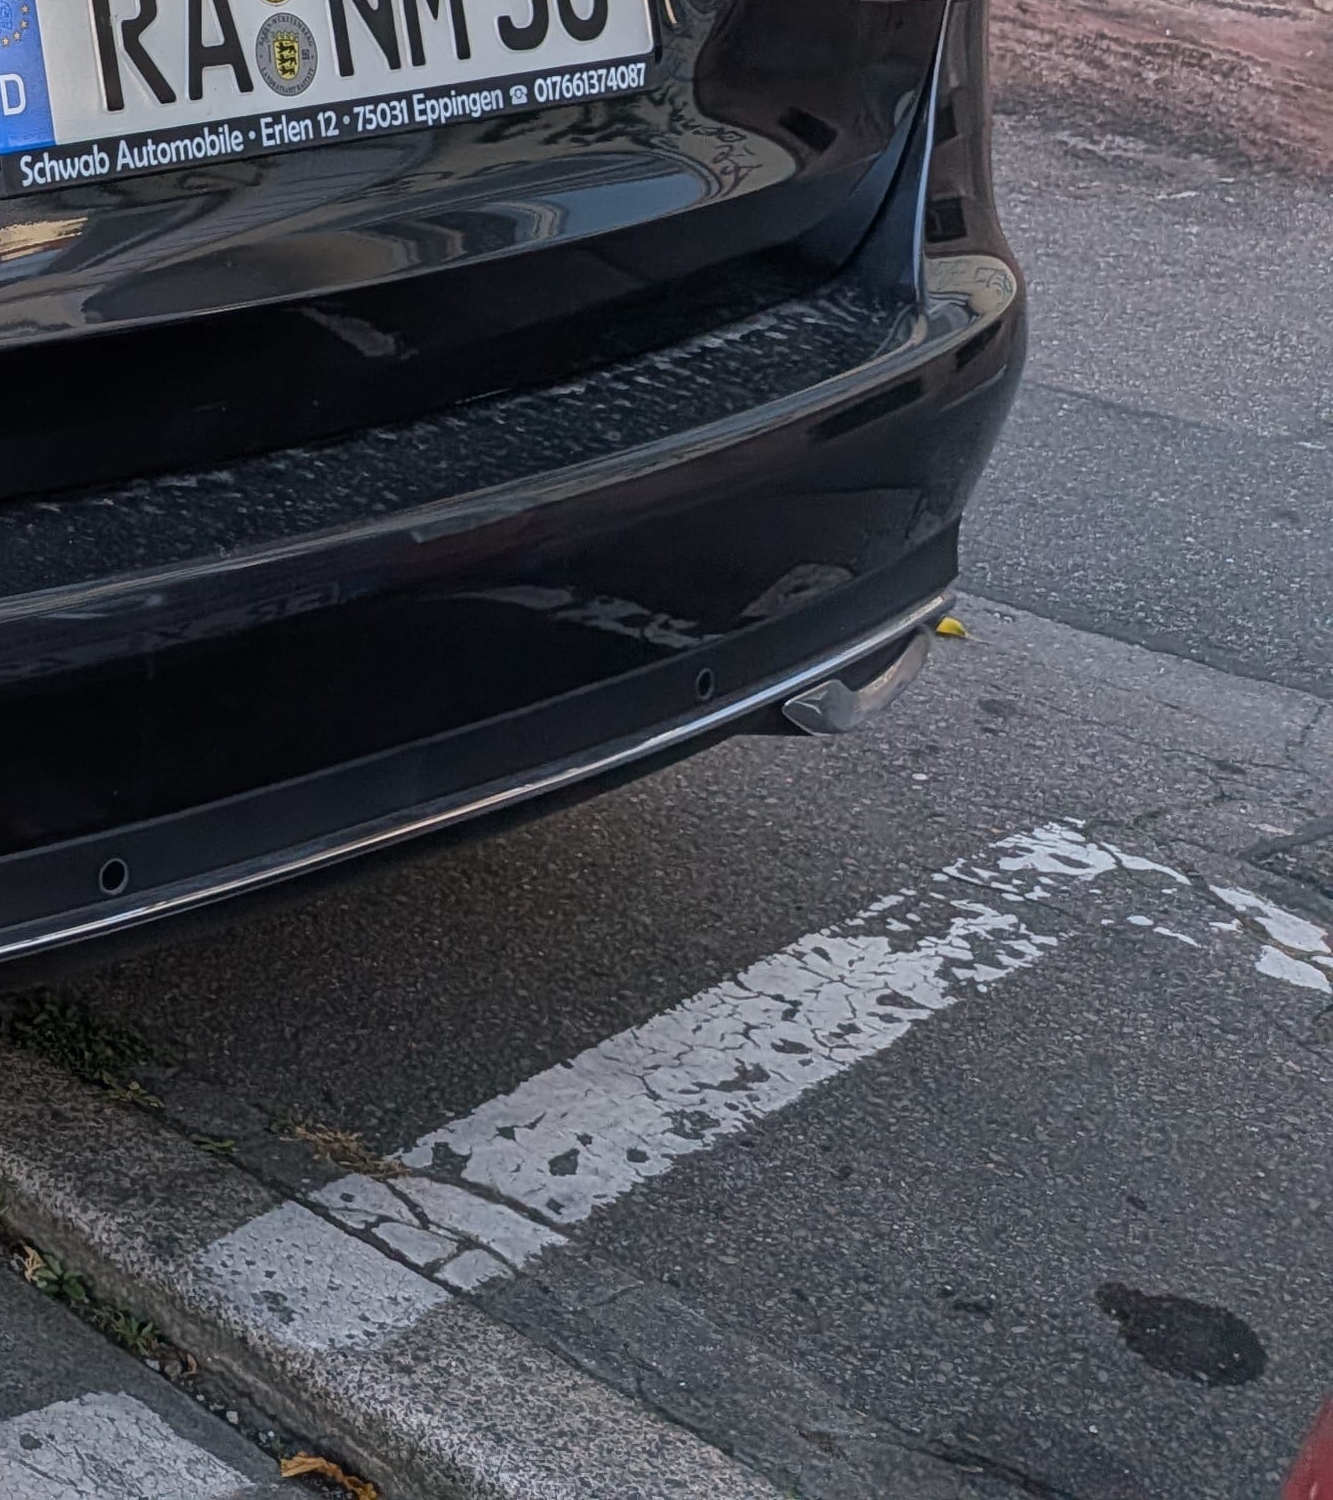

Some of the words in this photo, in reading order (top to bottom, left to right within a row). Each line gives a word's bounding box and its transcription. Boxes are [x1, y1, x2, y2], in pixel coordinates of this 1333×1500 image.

[0, 73, 26, 116] D
[19, 144, 110, 188] Schwab
[116, 123, 245, 172] Automobile
[259, 110, 314, 148] Erlen
[317, 108, 340, 137] 12
[353, 98, 409, 132] 75031
[413, 88, 504, 126] Eppingen
[534, 62, 647, 104] 017661374087
